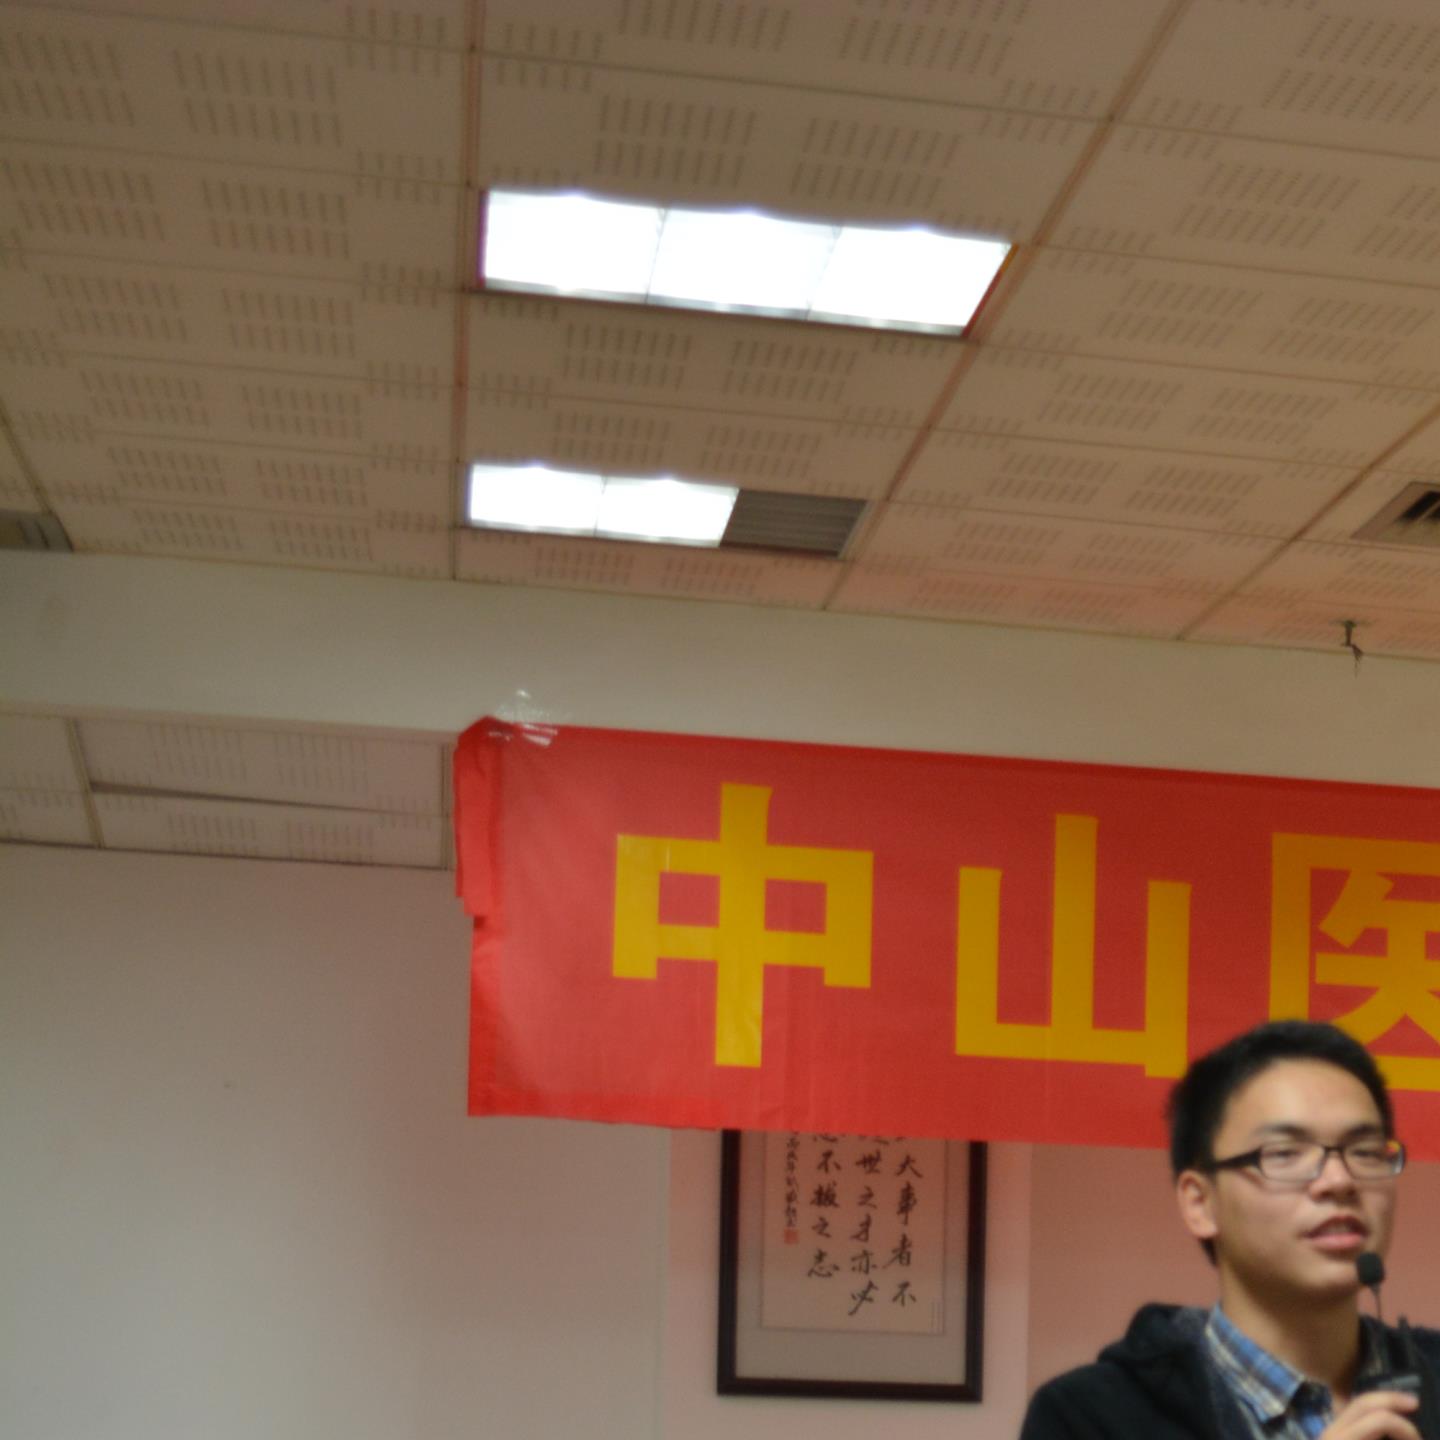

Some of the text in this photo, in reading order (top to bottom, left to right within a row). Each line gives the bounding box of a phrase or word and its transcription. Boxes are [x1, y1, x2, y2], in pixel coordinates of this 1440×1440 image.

[848, 1136, 889, 1317] 世之才亦必
[883, 1136, 923, 1308] 大事者不
